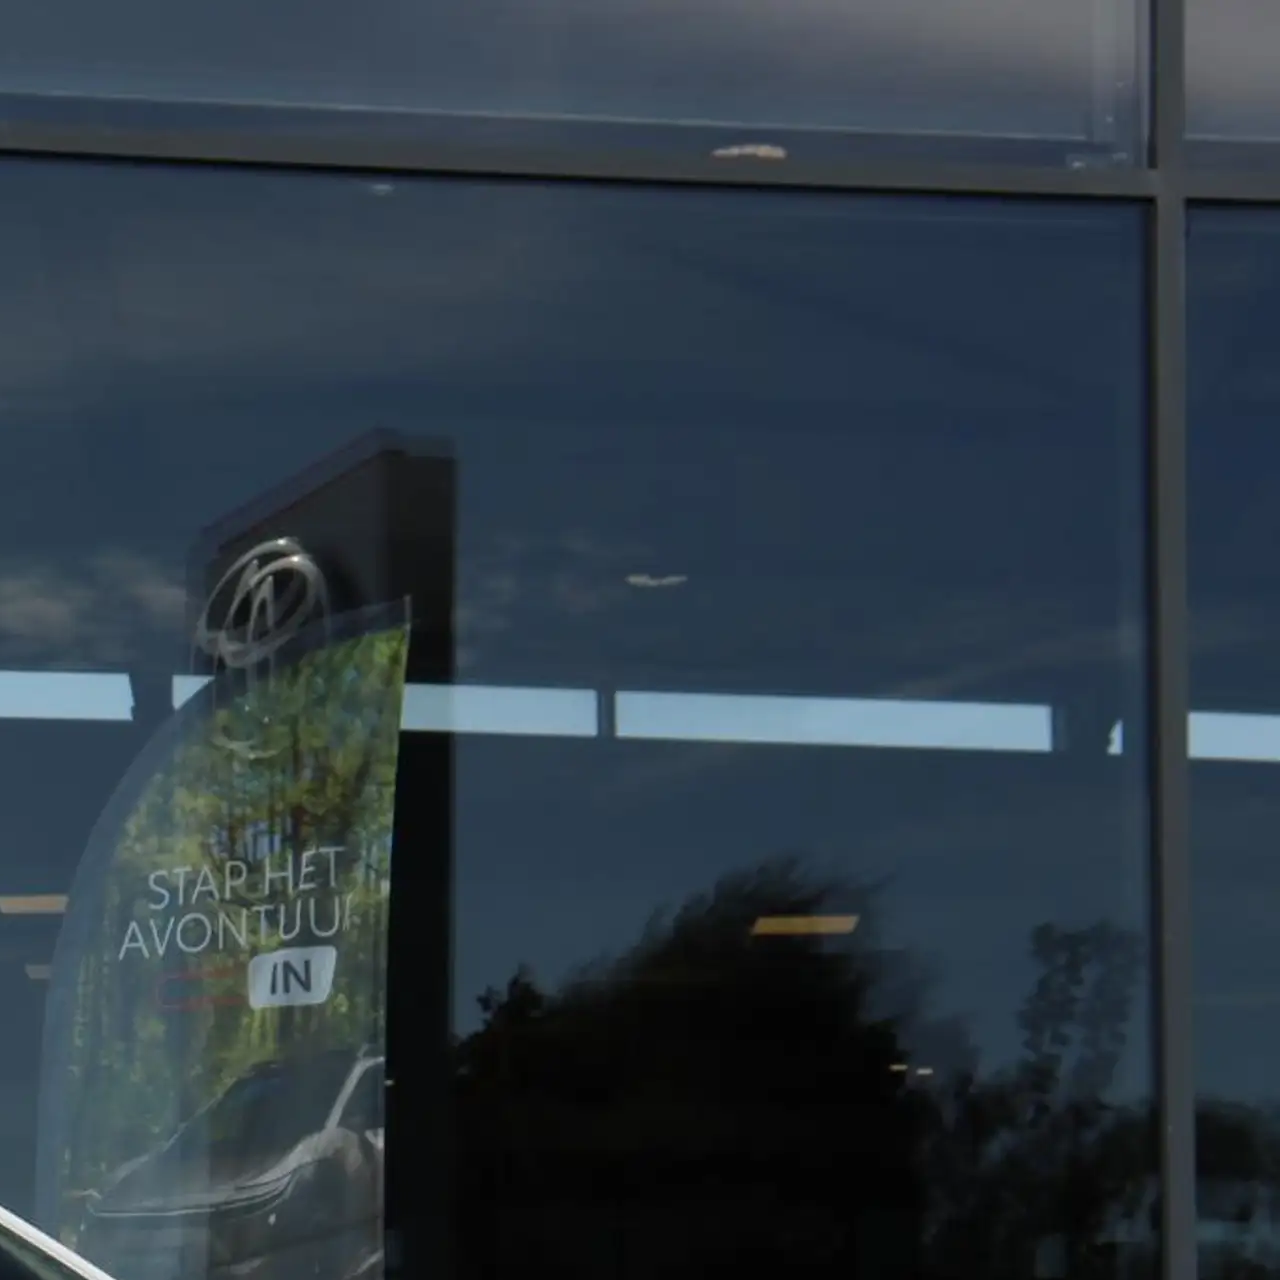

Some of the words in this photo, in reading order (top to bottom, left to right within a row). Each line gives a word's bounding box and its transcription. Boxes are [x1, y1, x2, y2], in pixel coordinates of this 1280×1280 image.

[148, 861, 247, 910] STAP
[265, 846, 346, 896] HET
[270, 960, 311, 995] IN
